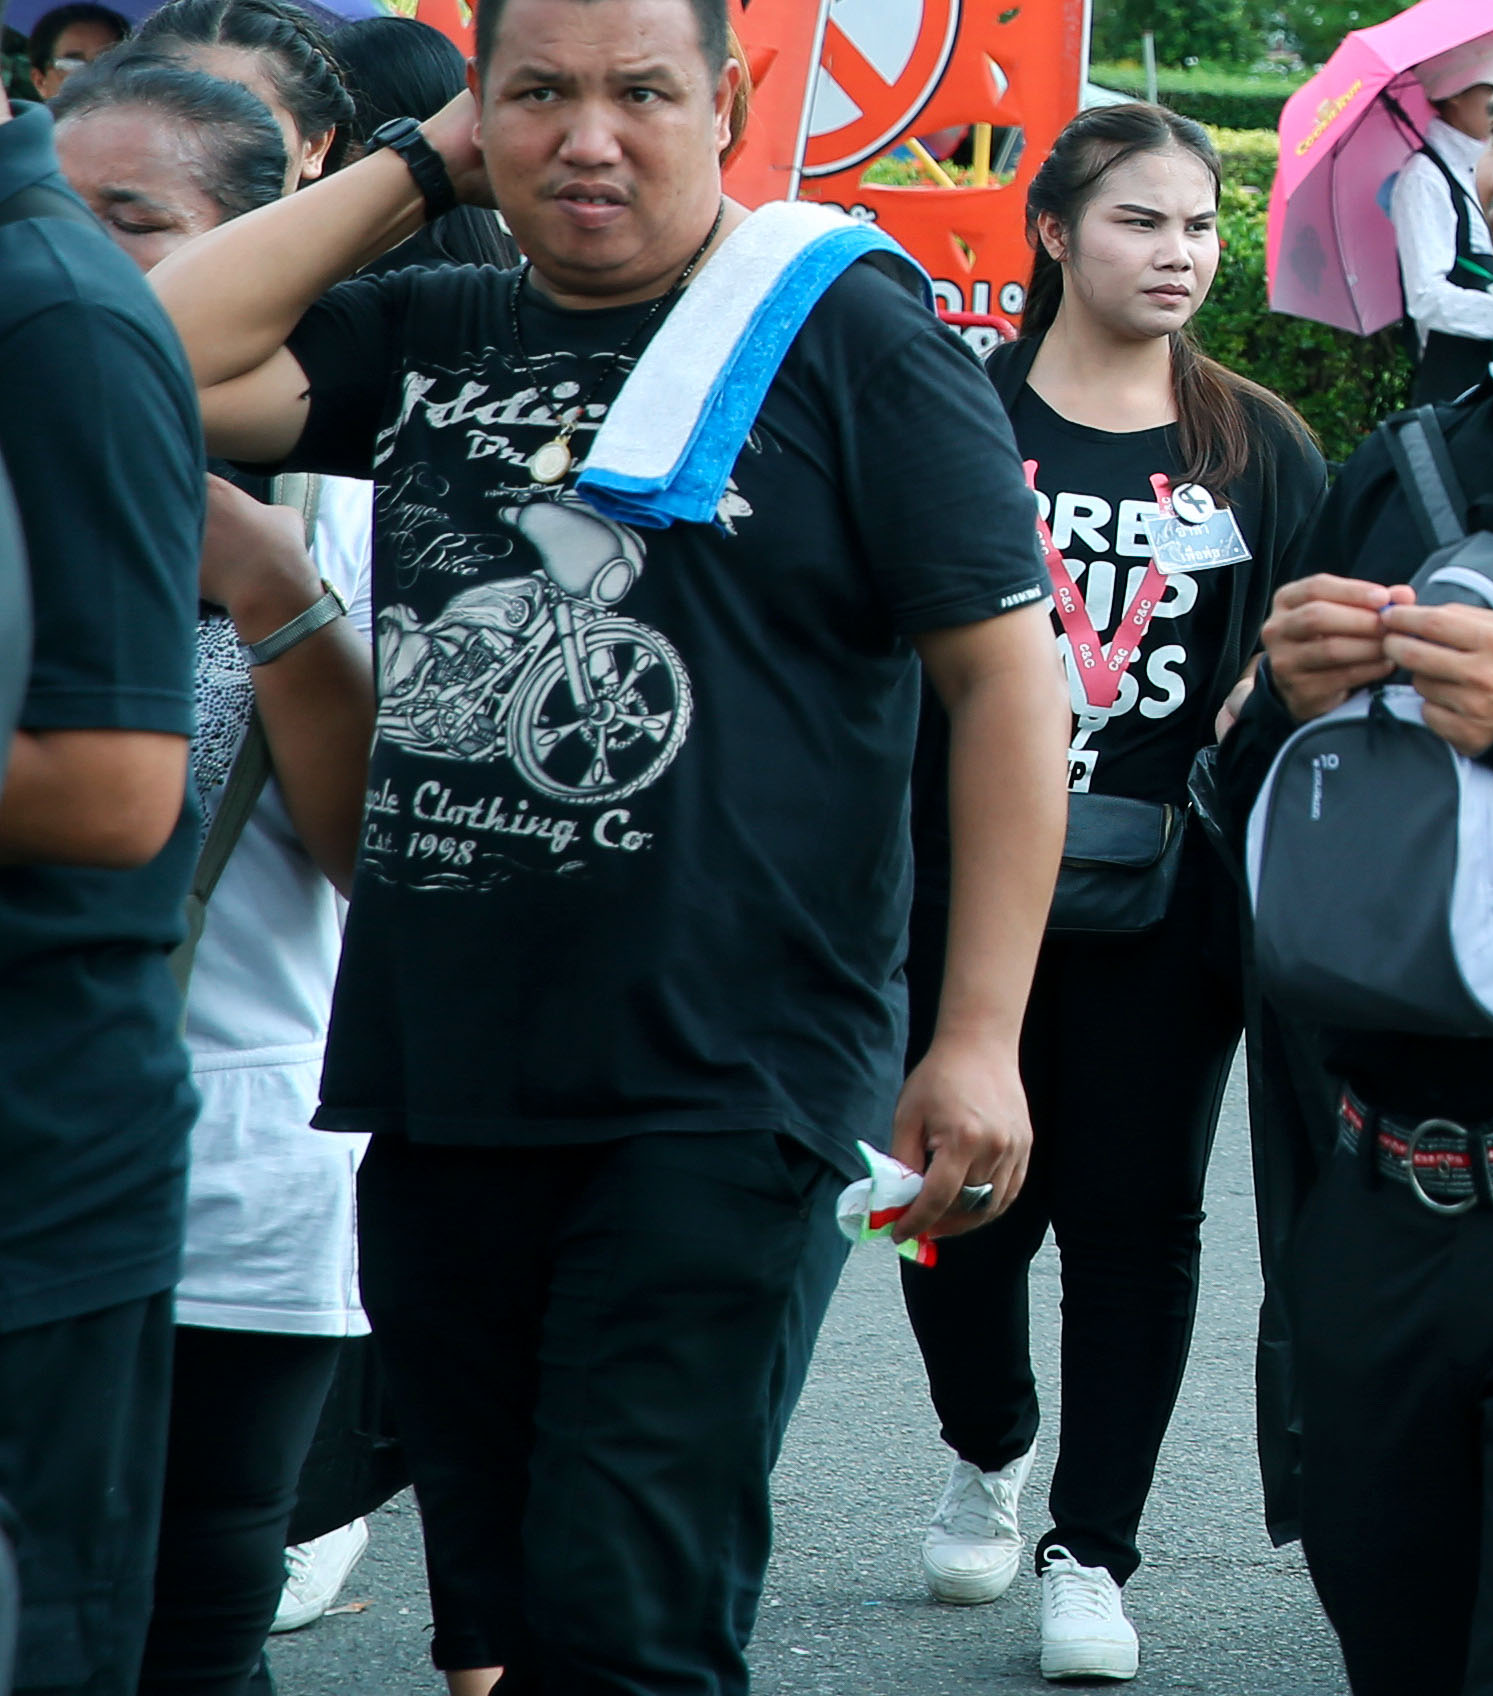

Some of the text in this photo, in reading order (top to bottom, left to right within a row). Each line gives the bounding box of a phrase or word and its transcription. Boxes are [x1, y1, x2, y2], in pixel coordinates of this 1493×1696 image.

[1059, 587, 1076, 614] C&C
[1132, 599, 1153, 626] C&C
[1079, 643, 1096, 669] C&C
[1107, 647, 1130, 672] C&C
[1321, 753, 1340, 770] 10
[413, 780, 580, 853] Clothing
[406, 831, 477, 865] 1998
